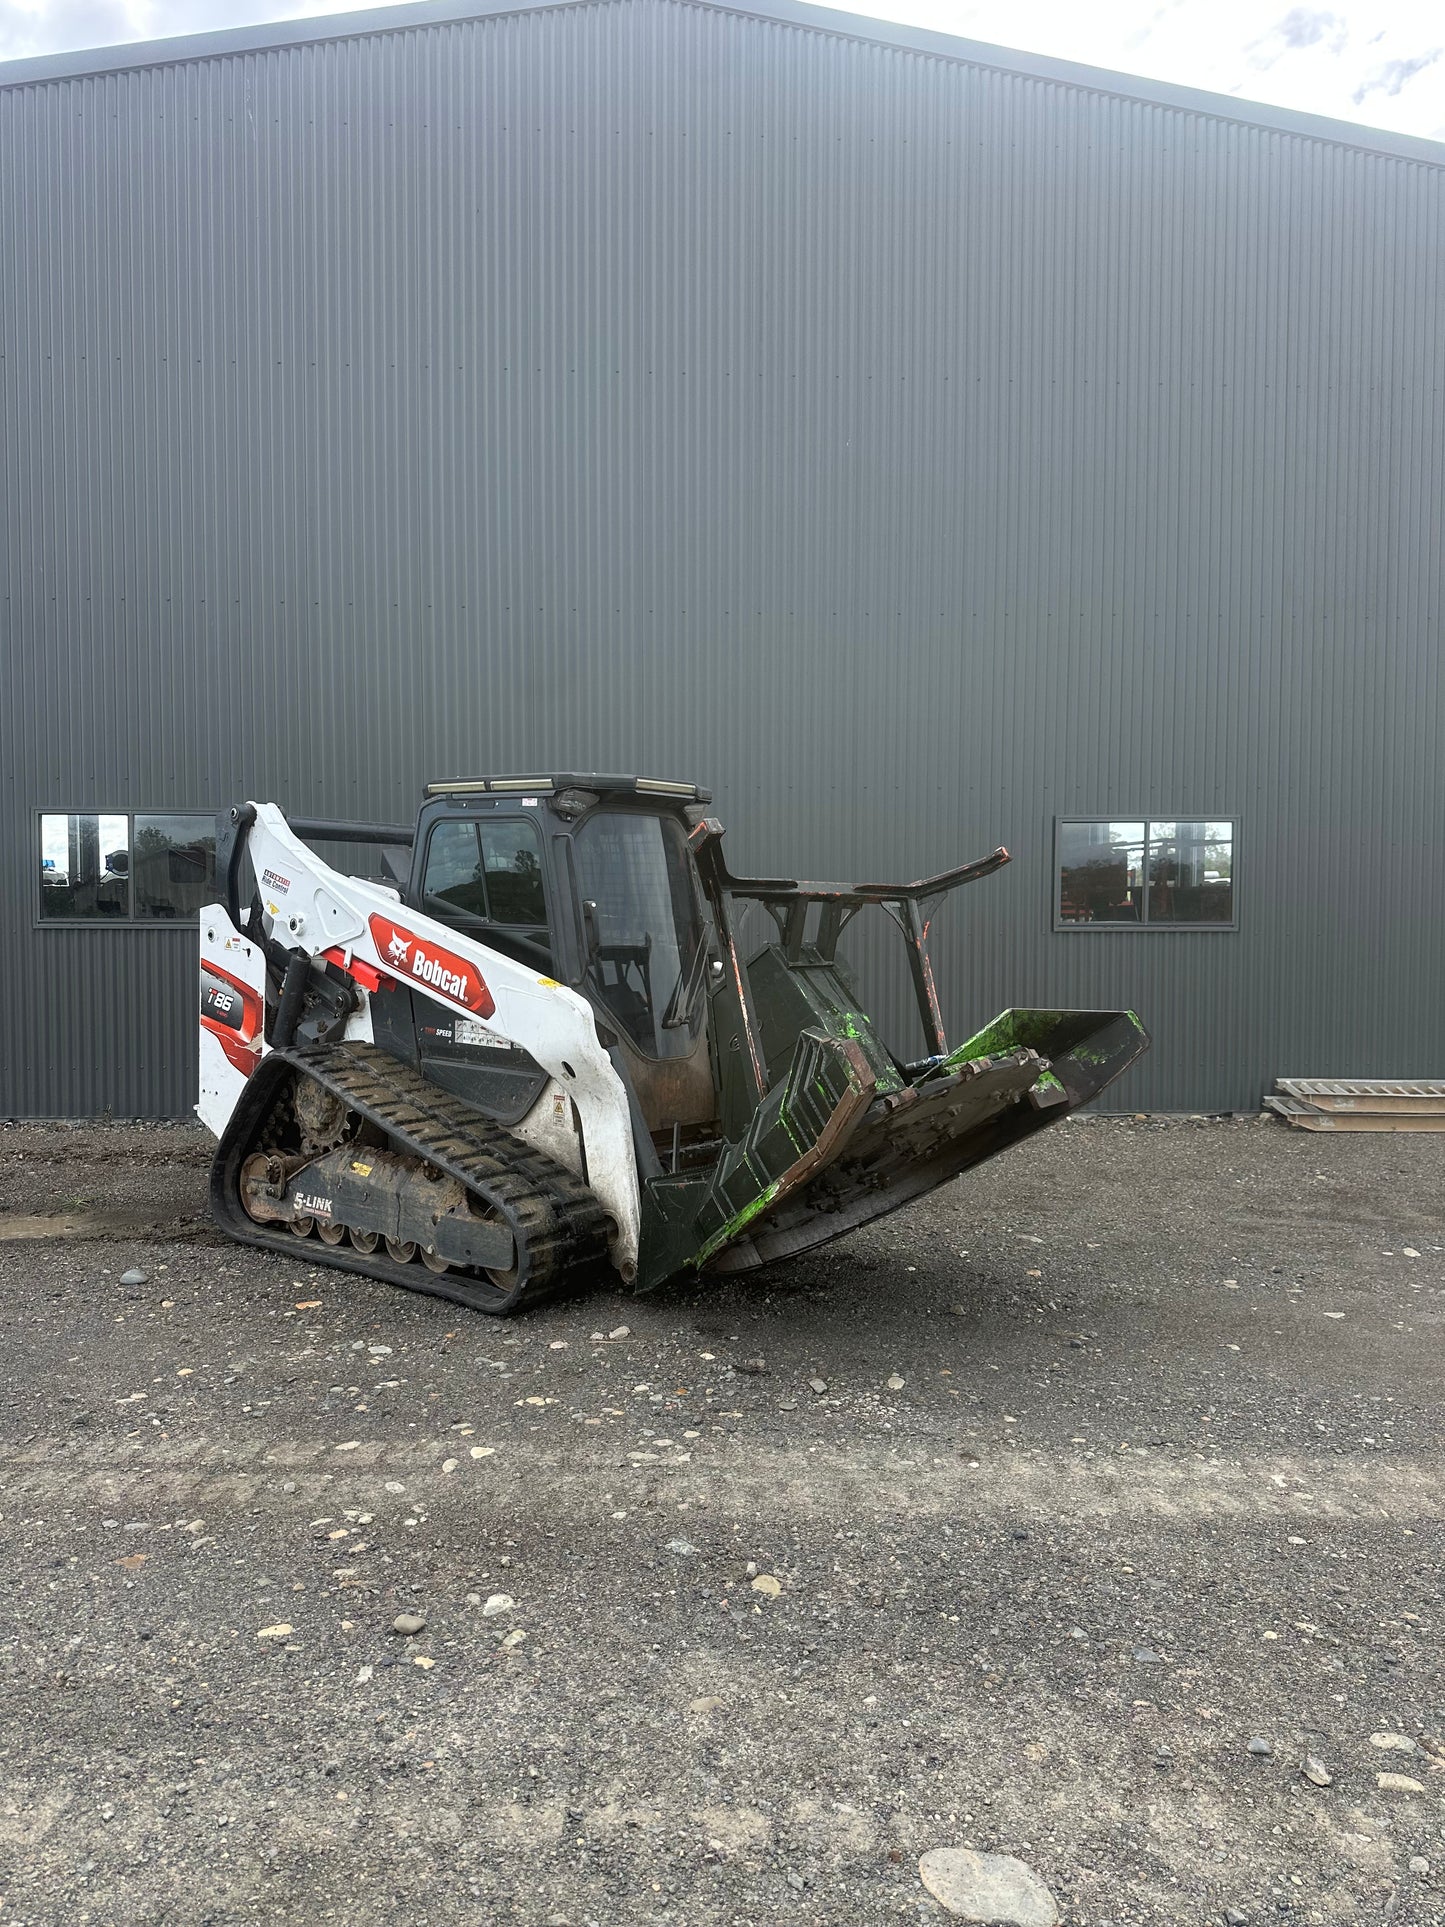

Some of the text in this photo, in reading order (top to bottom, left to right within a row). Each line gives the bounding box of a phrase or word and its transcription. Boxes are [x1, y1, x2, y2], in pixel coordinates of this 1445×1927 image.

[272, 880, 289, 894] Control
[412, 949, 467, 1000] Bobcat
[207, 987, 234, 1011] T86
[435, 1028, 452, 1037] SPEED
[293, 1192, 333, 1212] 5-LINK
